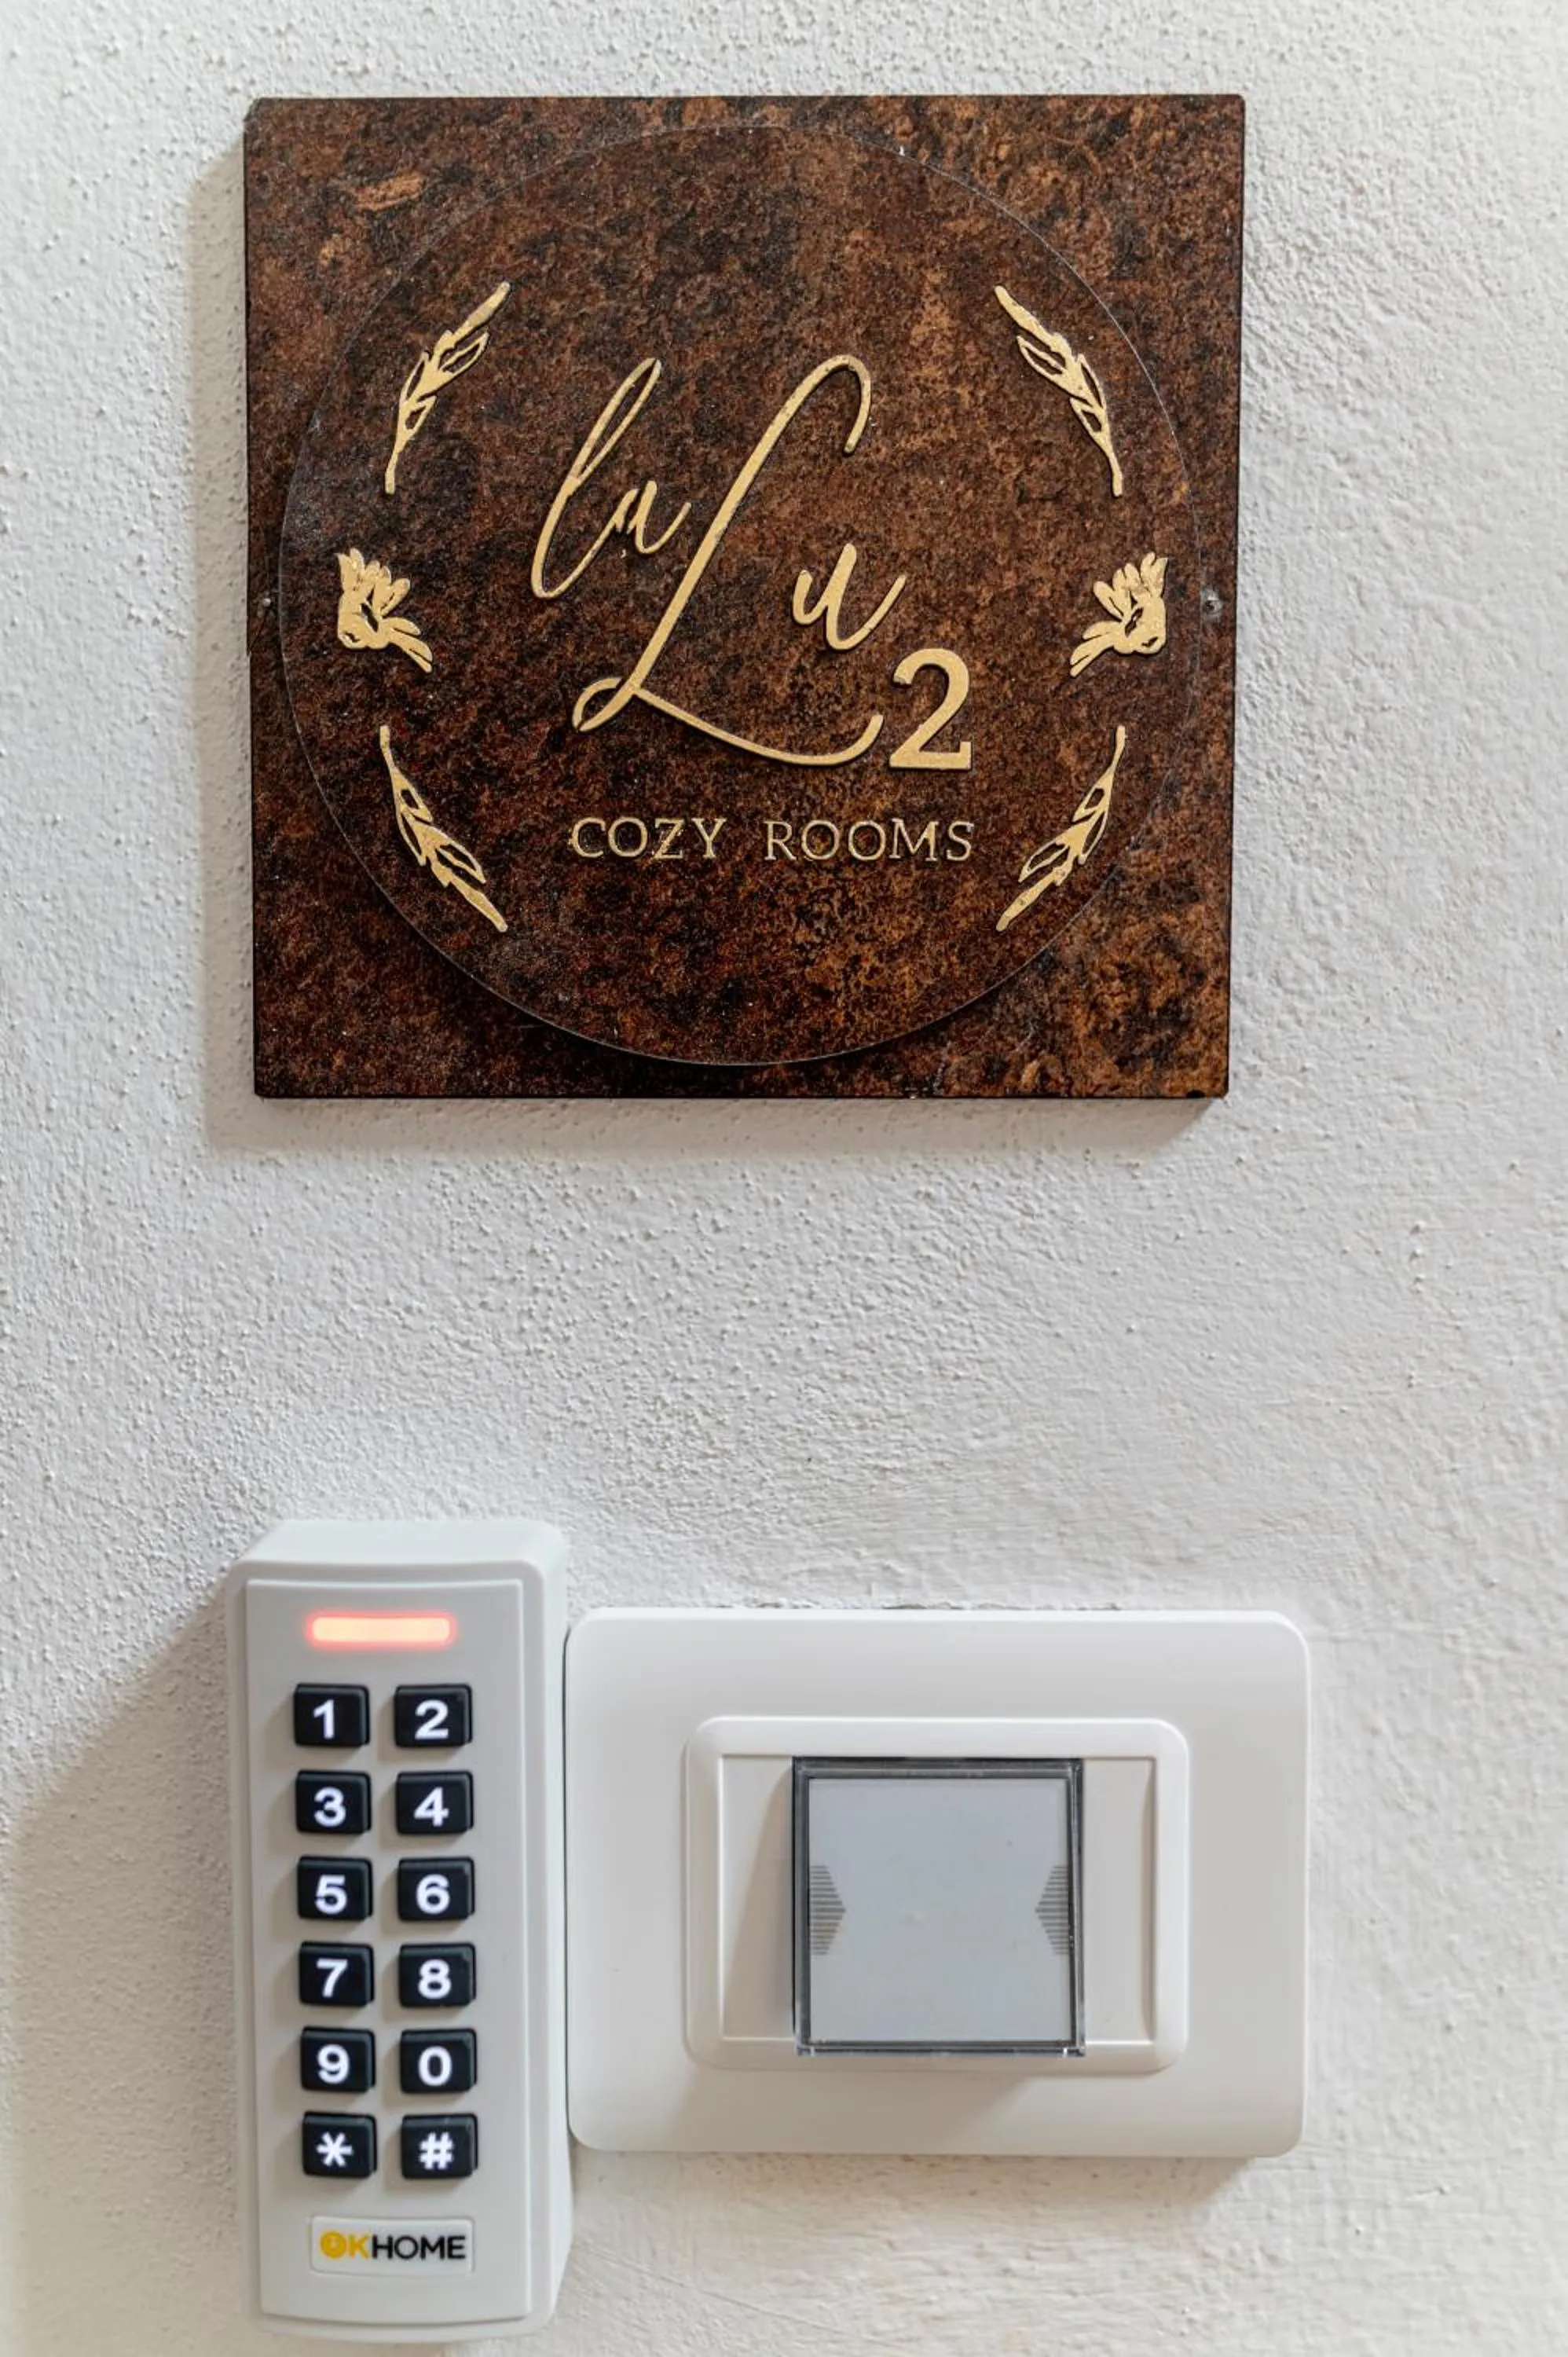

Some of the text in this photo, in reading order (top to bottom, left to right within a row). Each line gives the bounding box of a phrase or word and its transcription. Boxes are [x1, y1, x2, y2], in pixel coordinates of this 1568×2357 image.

[888, 647, 973, 771] 2
[569, 817, 973, 862] COZY ROOMS
[314, 1700, 448, 1739] 1 2
[315, 1788, 449, 1826] 3 4
[317, 1875, 449, 1913] 5 6
[317, 1959, 451, 1998] 7 8
[318, 2045, 451, 2085] 9 0
[420, 2132, 452, 2168] #
